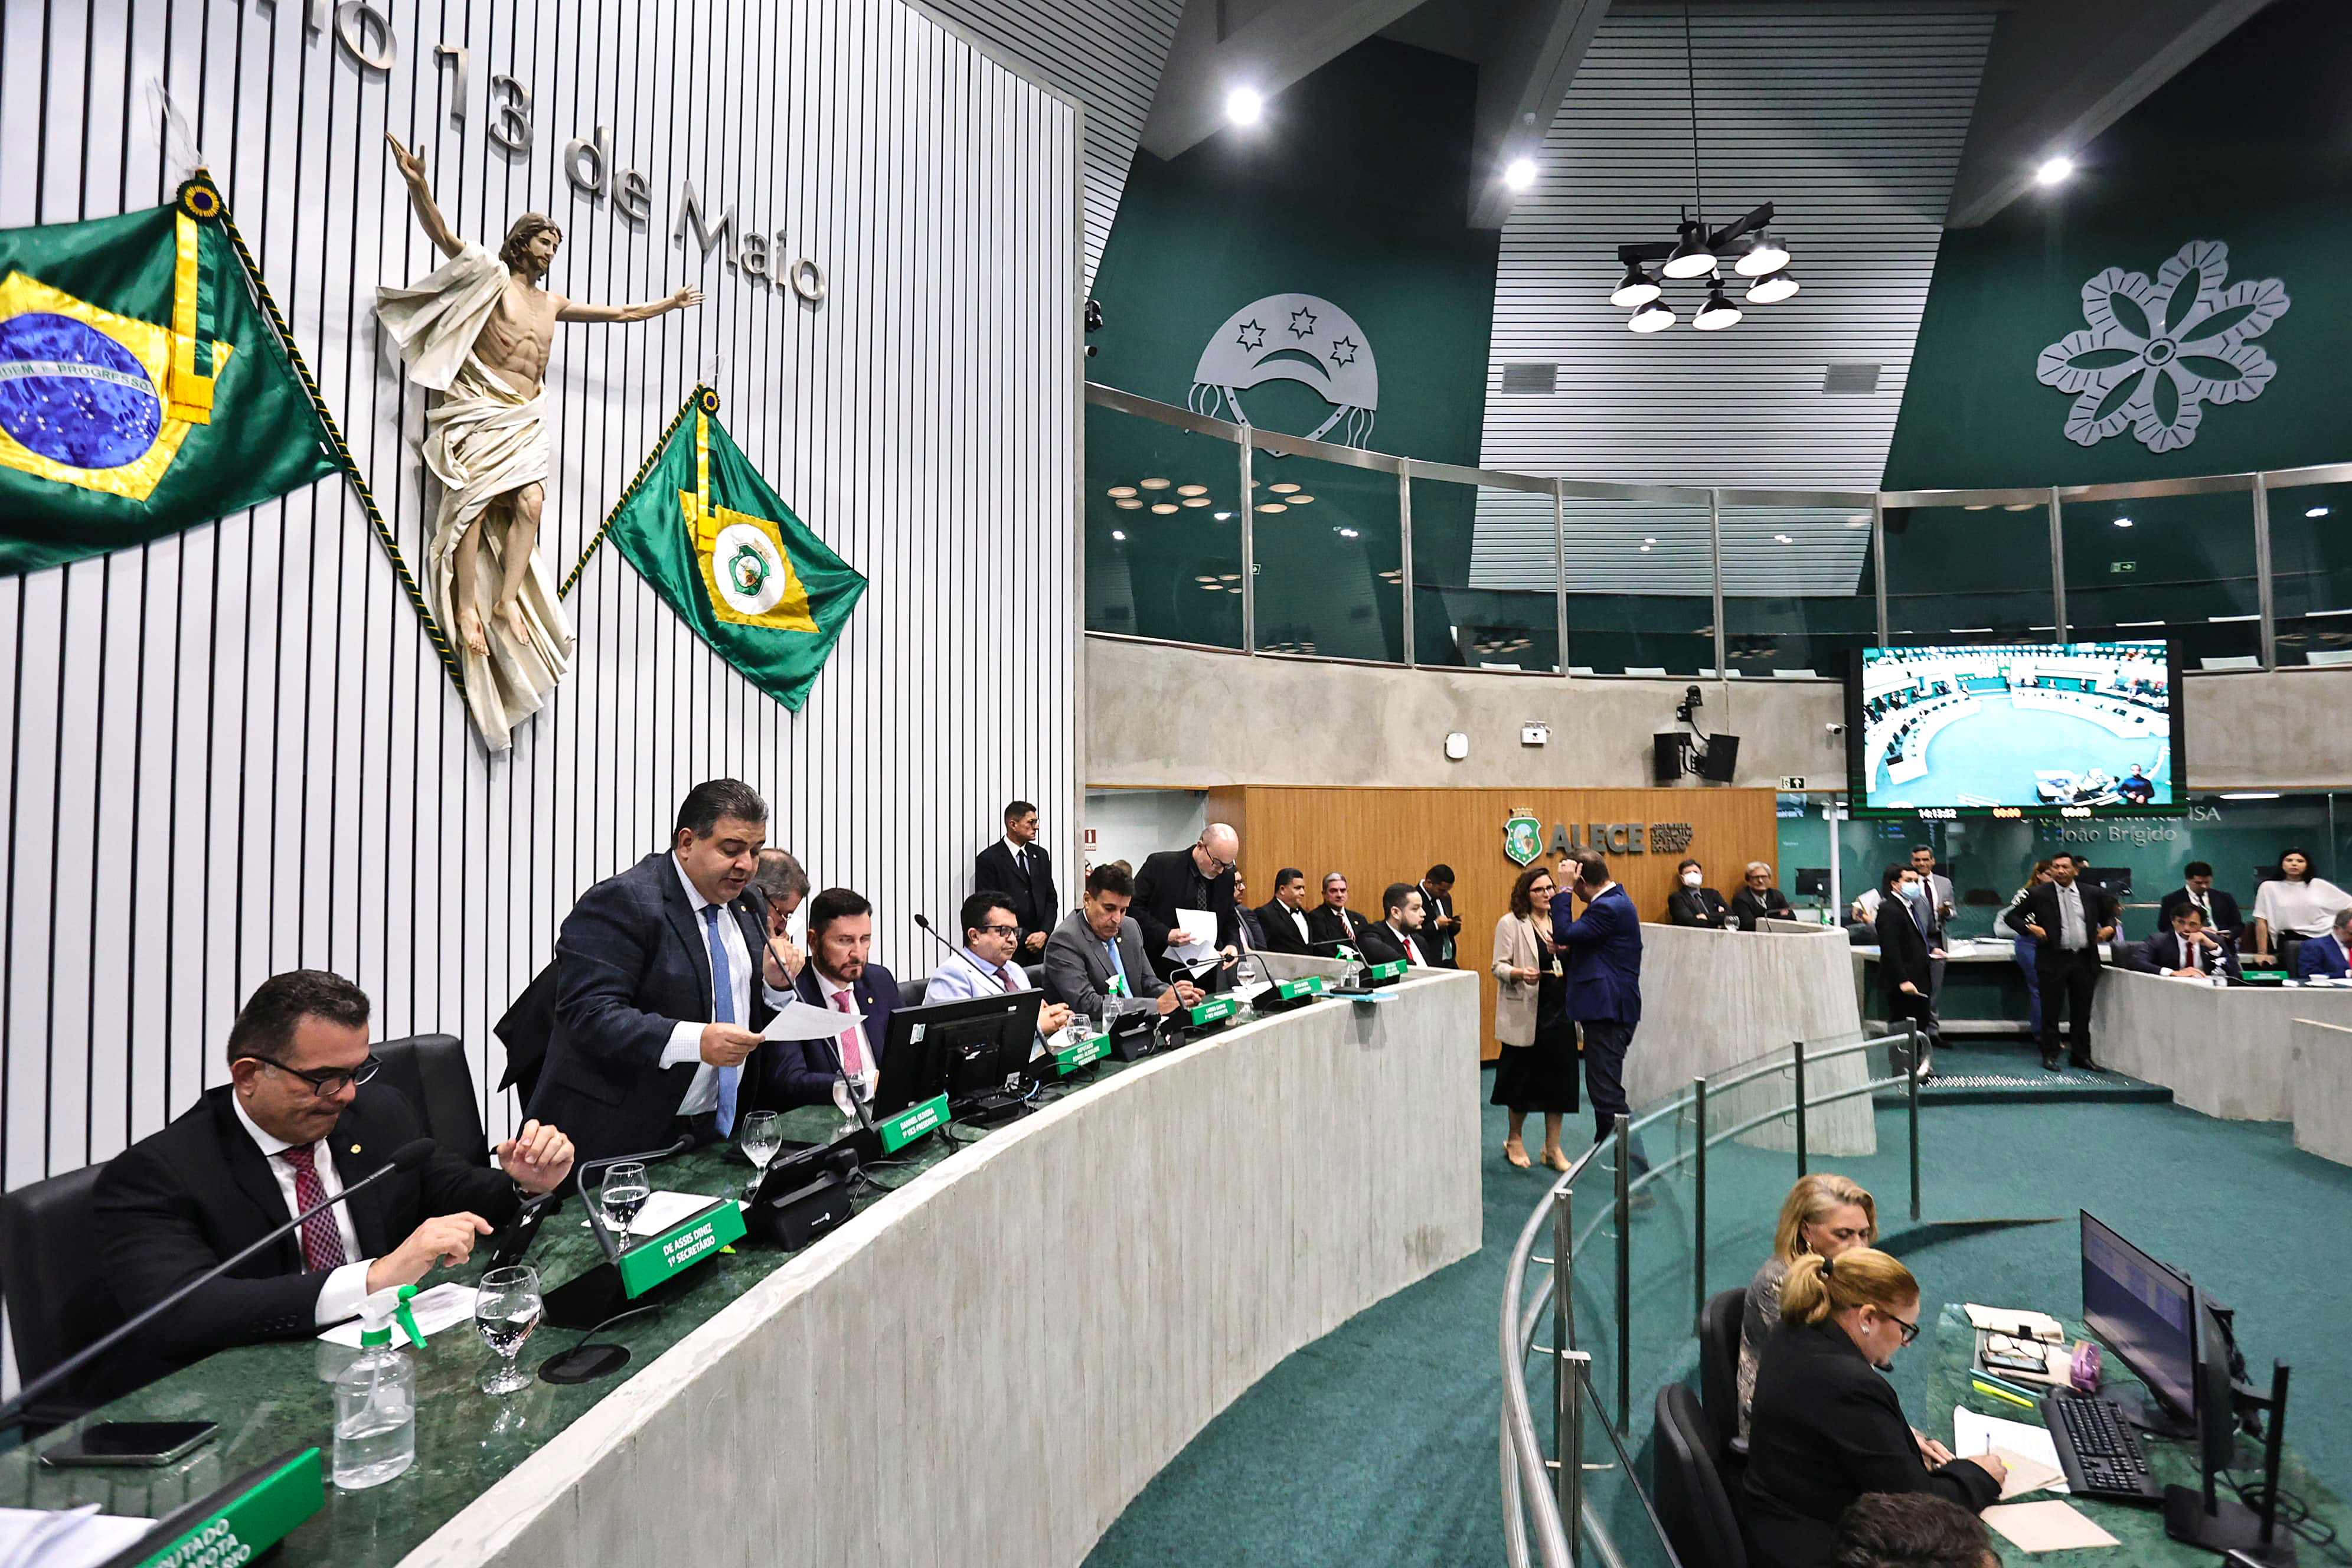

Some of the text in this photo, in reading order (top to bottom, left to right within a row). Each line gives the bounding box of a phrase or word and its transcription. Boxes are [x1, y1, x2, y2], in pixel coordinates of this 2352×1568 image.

[434, 44, 534, 152] 13
[564, 126, 652, 220] de
[674, 179, 825, 300] Maio
[57, 364, 149, 390] PROGRESSO
[1547, 823, 1646, 854] ALECE
[663, 1222, 713, 1256] DE ASSIS DINIZ
[676, 1234, 716, 1264] SECRETÁRIO
